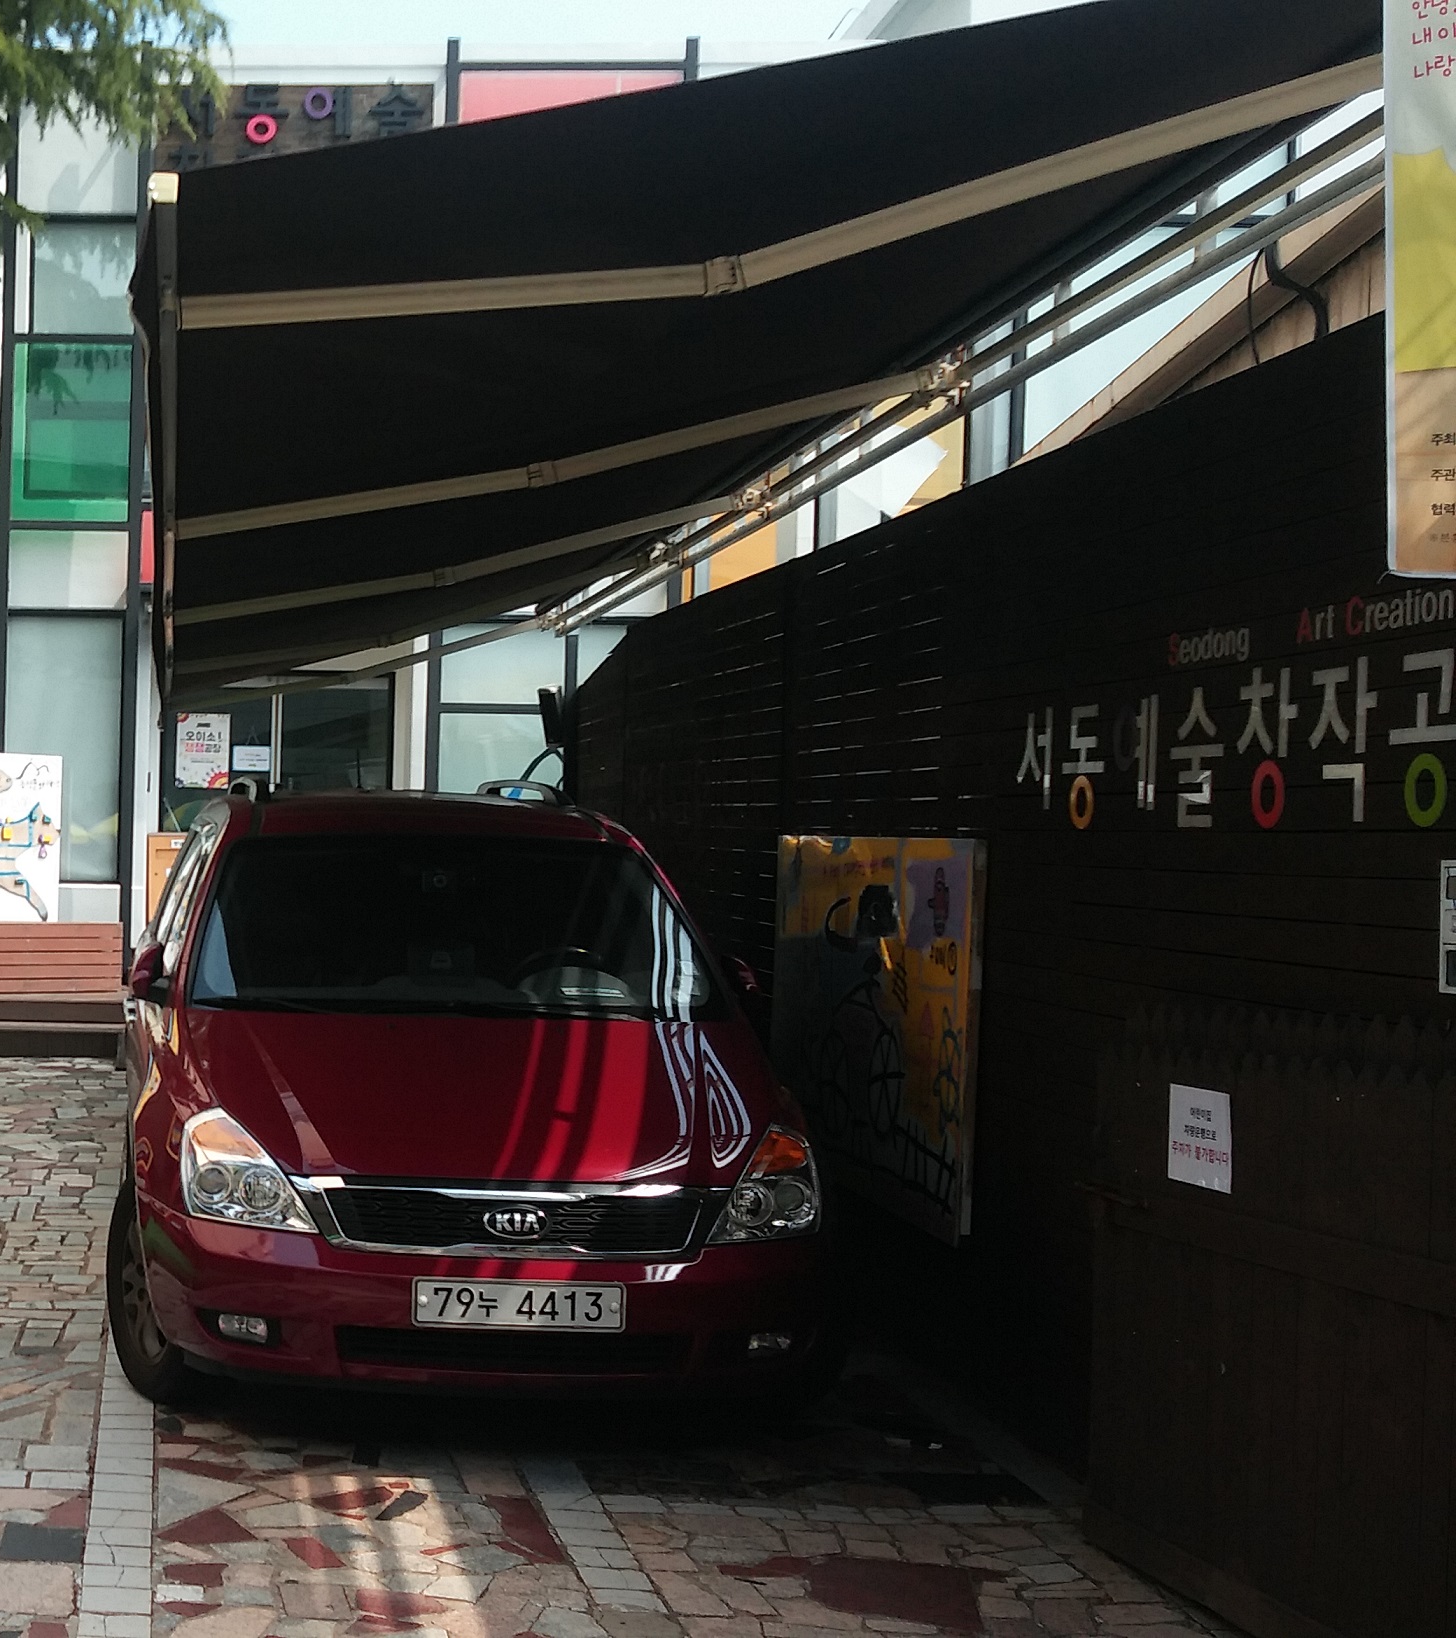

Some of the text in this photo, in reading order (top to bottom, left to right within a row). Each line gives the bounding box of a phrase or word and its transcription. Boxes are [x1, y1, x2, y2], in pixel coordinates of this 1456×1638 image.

[1413, 54, 1456, 78] 나랑
[1431, 433, 1456, 446] 주최
[1431, 468, 1456, 482] 주관
[1431, 503, 1456, 516] 협력
[1168, 588, 1454, 667] Seodong Art Creation
[1195, 1146, 1229, 1165] 불가합니다
[495, 1212, 540, 1232] KIA
[433, 1286, 603, 1322] 79누 4413
